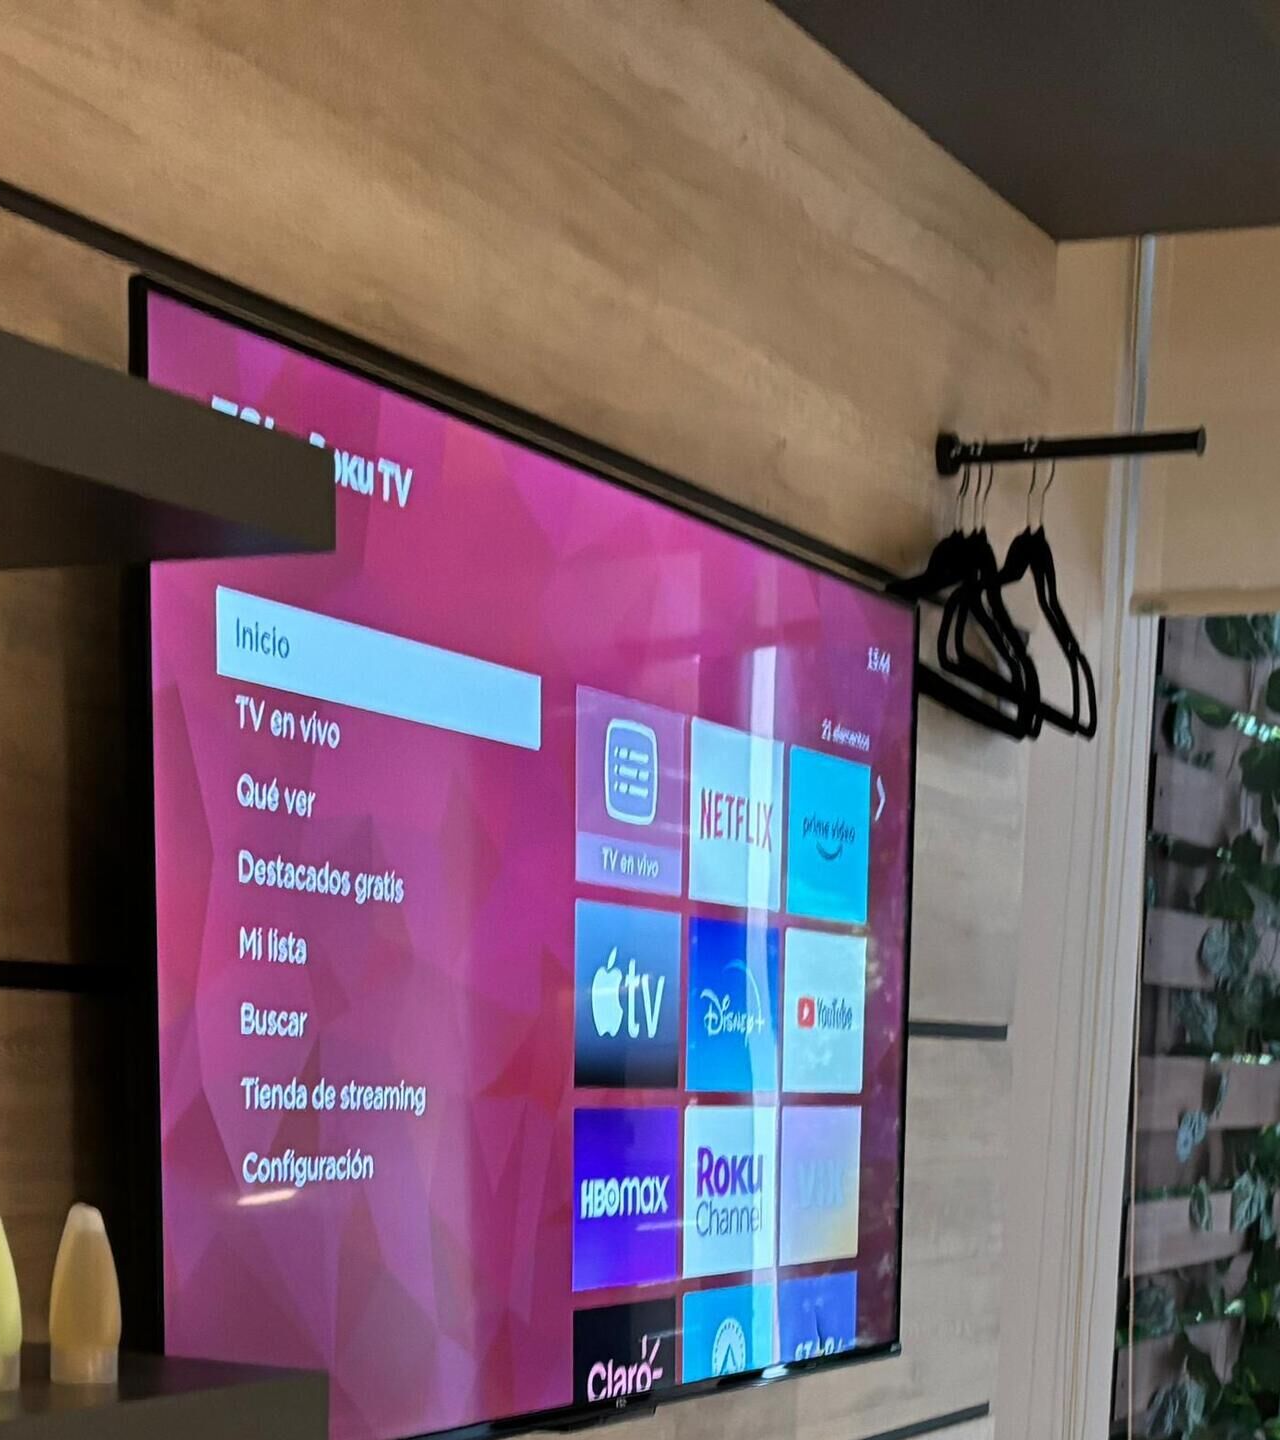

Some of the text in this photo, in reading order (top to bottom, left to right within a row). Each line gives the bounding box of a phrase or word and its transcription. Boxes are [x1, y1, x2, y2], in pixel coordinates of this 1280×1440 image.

[377, 458, 413, 508] TV
[235, 618, 290, 659] Inicio
[235, 694, 341, 749] TV en vivo
[236, 773, 316, 818] Qué ver
[699, 786, 774, 853] NETFLIX
[238, 849, 405, 905] Destacados gratis
[601, 847, 660, 878] TV en vivo
[239, 926, 308, 965] Mi lista
[240, 1001, 308, 1038] Buscar
[817, 998, 853, 1030] YouTube
[240, 1077, 427, 1117] Tienda de streaming
[242, 1148, 374, 1188] Configuración
[695, 1200, 763, 1237] Channel
